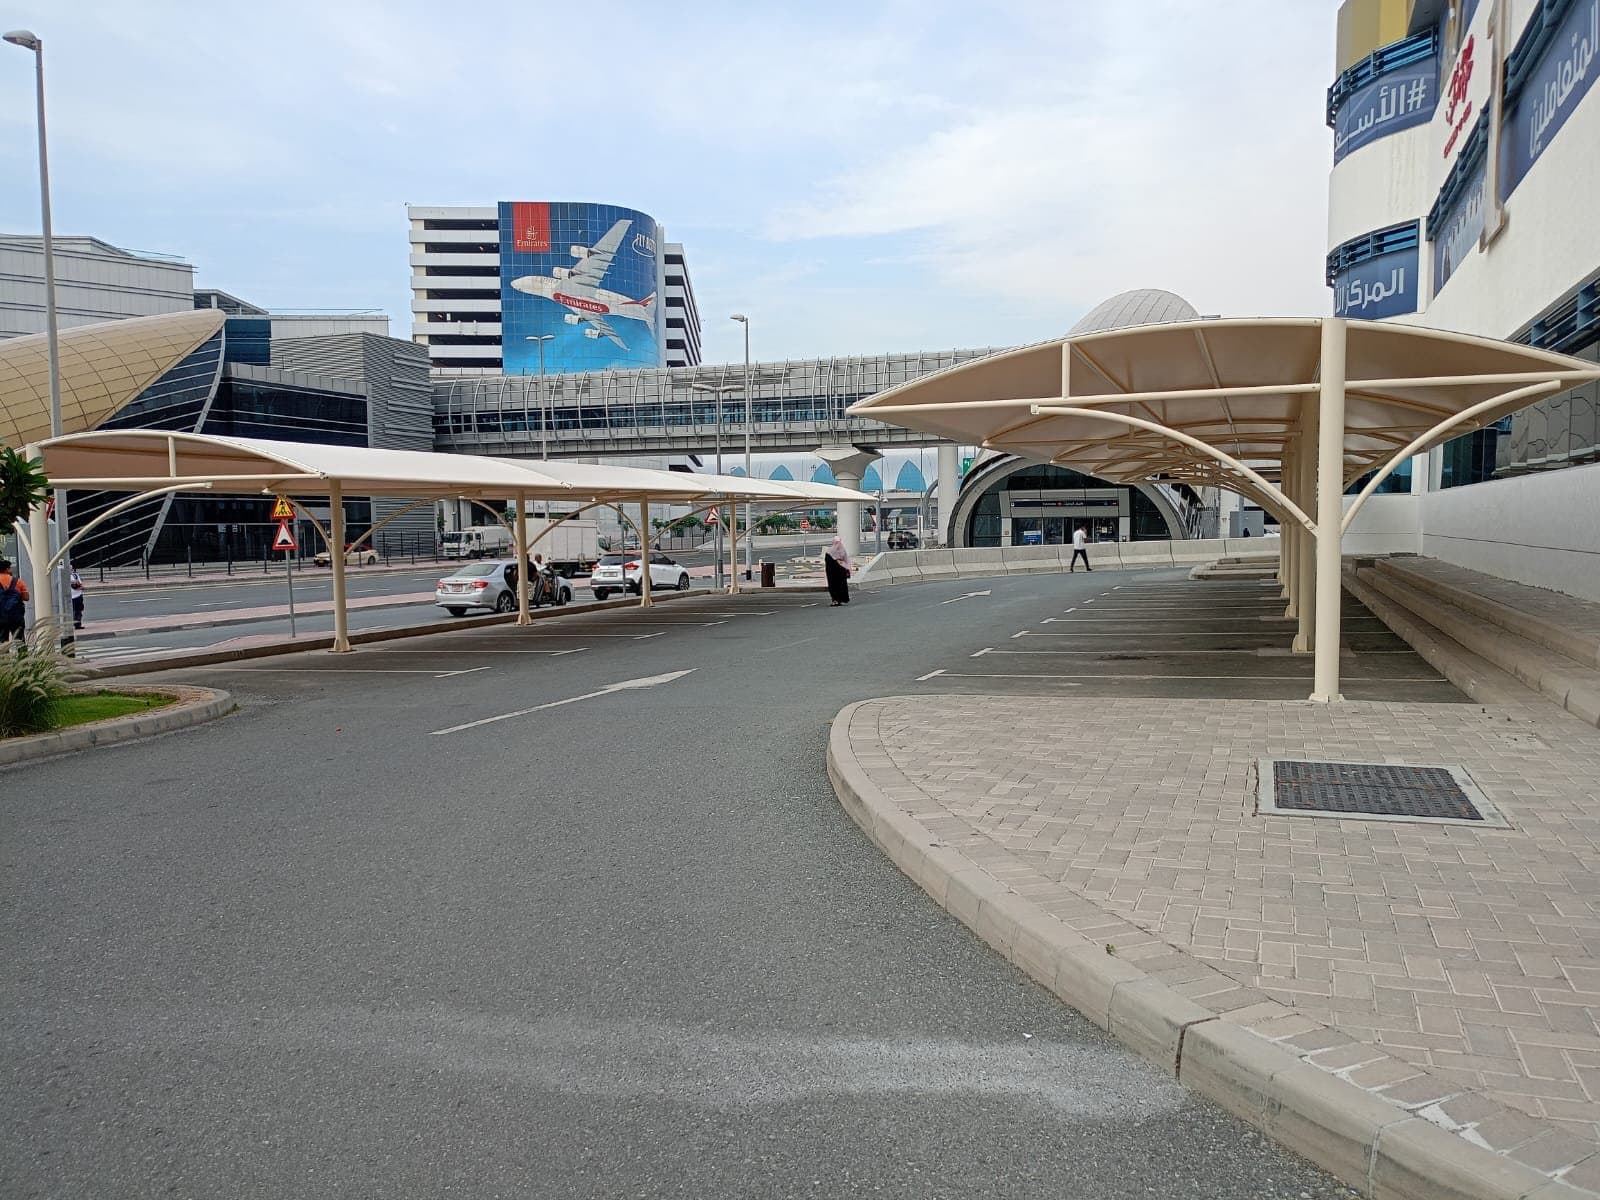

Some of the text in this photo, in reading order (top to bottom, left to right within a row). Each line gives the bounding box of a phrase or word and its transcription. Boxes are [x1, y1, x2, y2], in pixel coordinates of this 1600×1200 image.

[1530, 1, 1599, 158] المتعاملين
[516, 239, 548, 247] Emirates
[559, 295, 602, 312] Emirates
[1344, 267, 1405, 315] المركز
